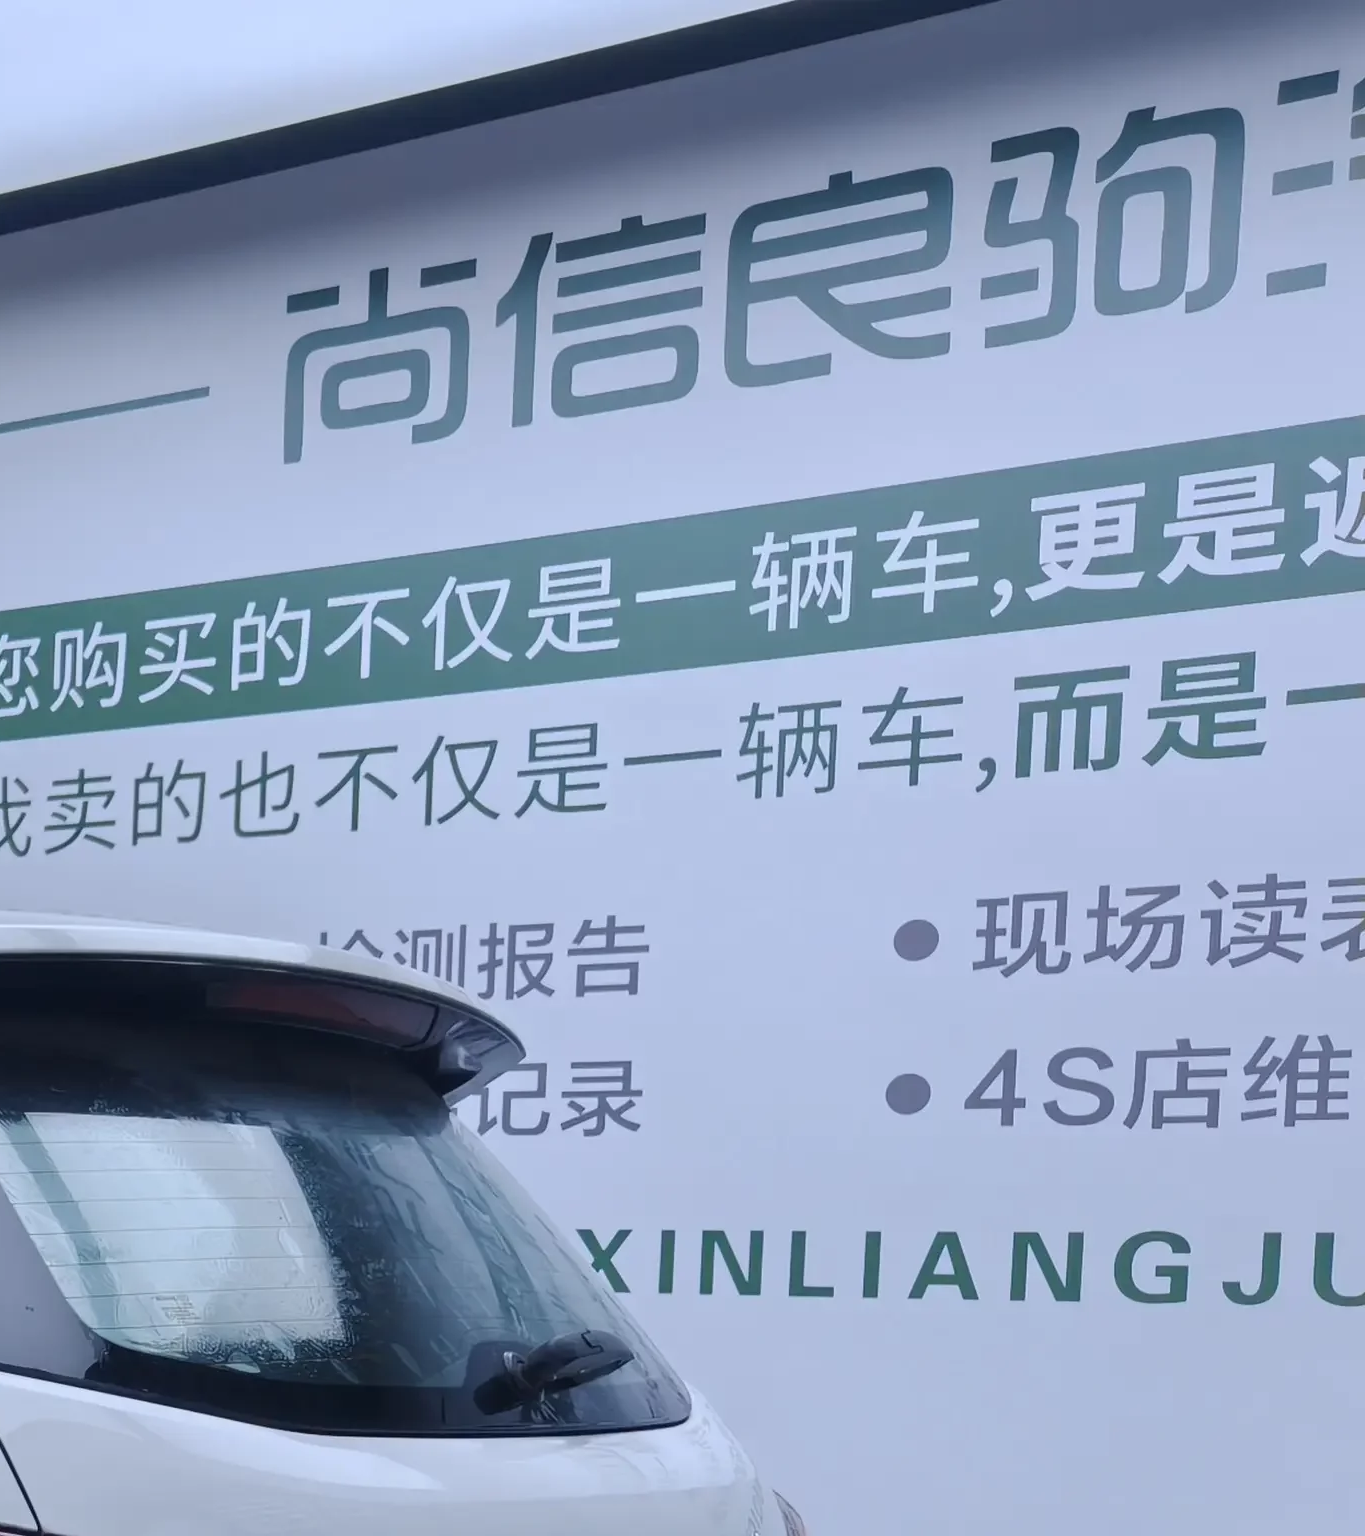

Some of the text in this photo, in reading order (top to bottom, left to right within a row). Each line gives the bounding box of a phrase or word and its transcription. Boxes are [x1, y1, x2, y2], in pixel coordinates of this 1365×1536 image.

[284, 70, 1365, 463] 尚信良驹
[318, 914, 650, 1001] 测报告
[964, 1034, 1353, 1130] 4S店维
